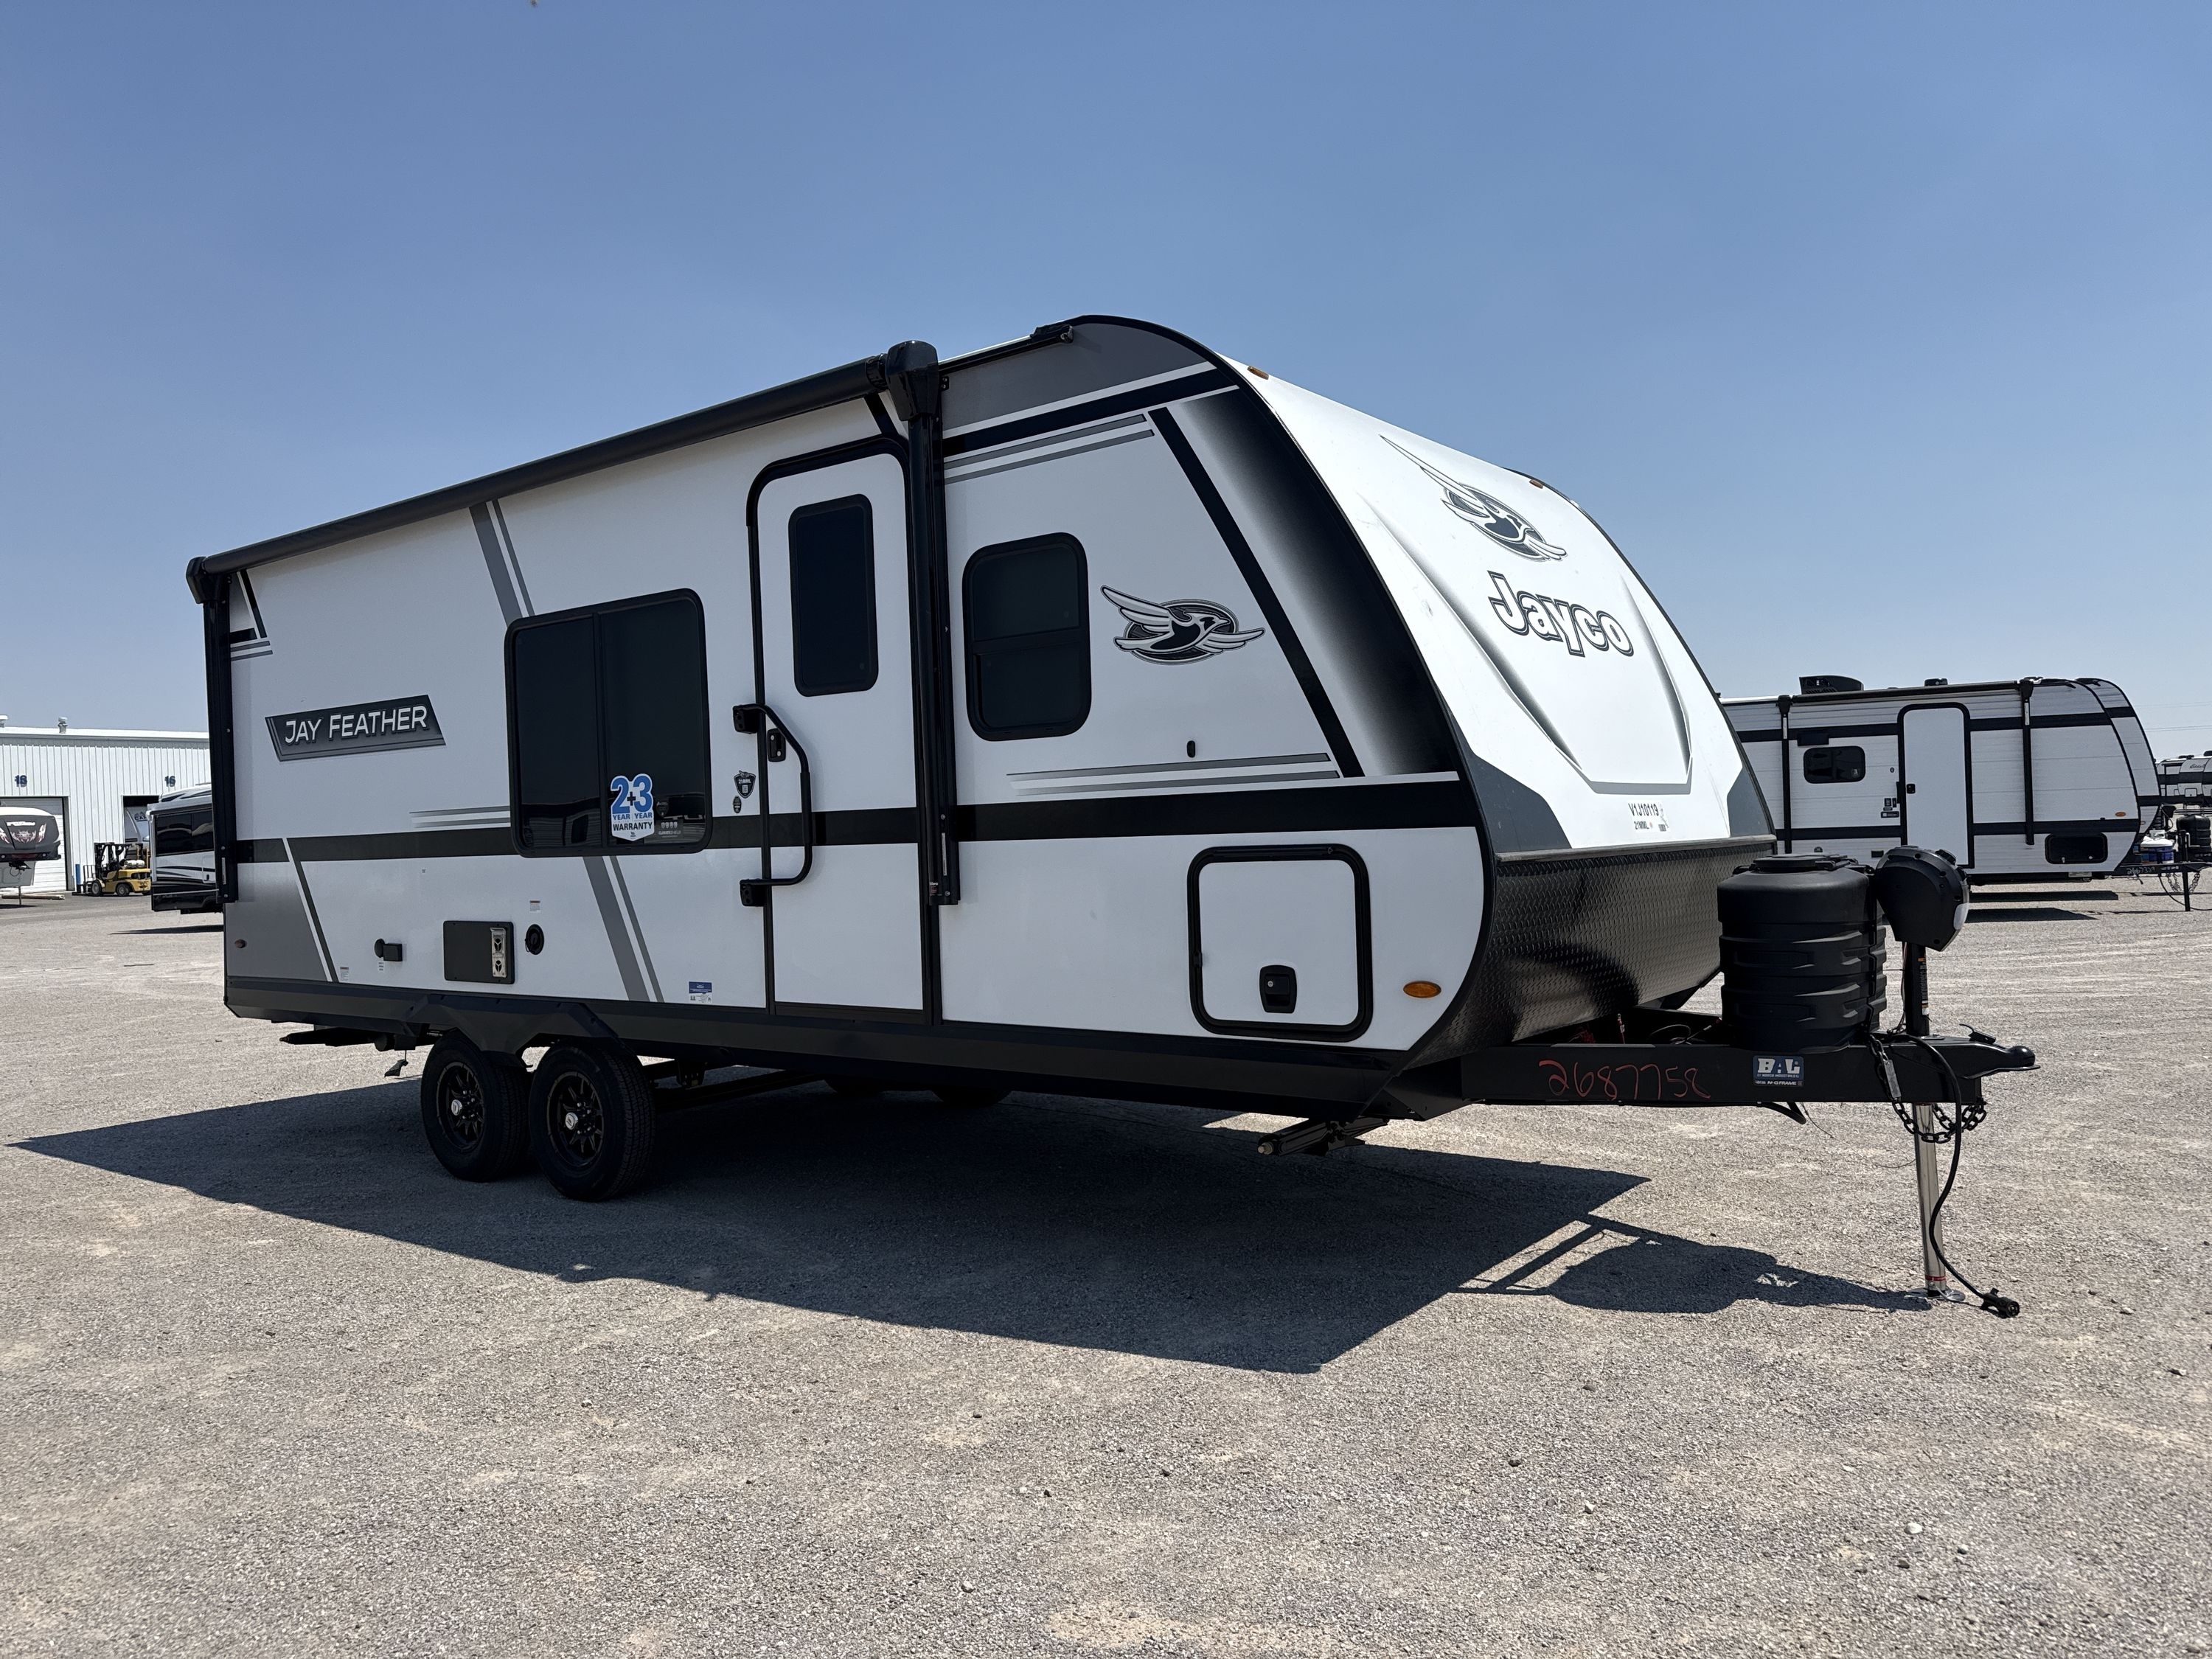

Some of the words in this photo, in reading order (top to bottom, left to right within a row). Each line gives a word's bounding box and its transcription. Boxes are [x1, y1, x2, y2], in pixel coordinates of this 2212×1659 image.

[1487, 570, 1634, 657] Jayco
[285, 718, 322, 744] JAY
[329, 705, 428, 739] FEATHER
[164, 776, 175, 787] 16
[613, 821, 653, 831] WARRANTY
[1758, 1058, 1800, 1074] BAL
